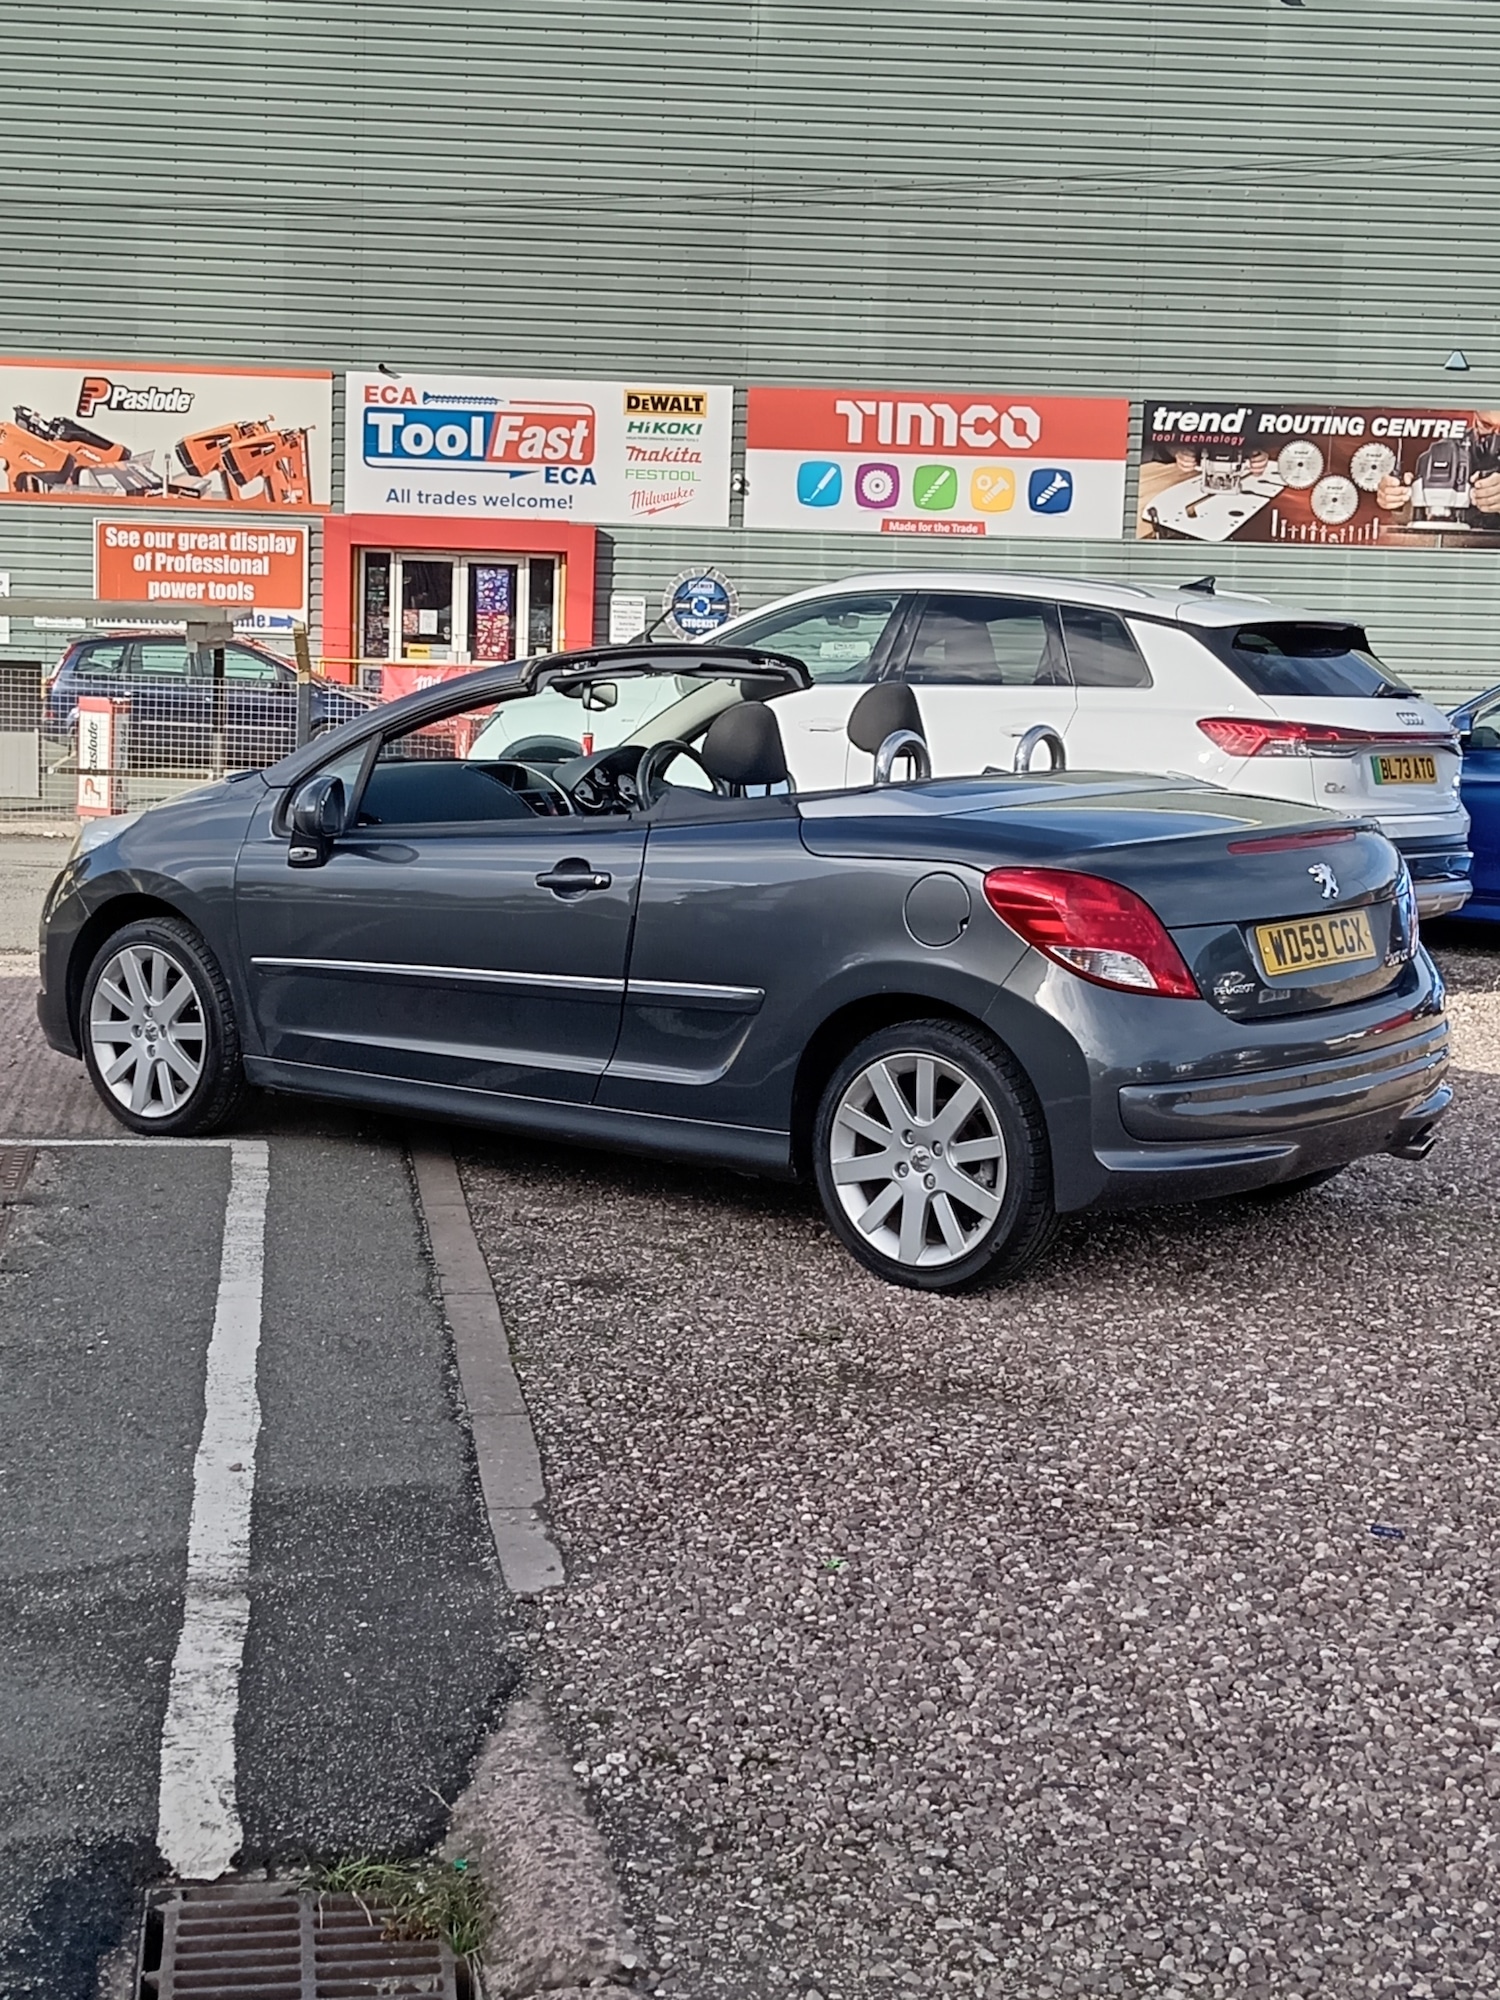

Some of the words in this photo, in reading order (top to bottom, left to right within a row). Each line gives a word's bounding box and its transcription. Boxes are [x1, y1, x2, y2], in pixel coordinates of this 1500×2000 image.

[109, 385, 192, 413] Paslode
[364, 386, 417, 405] ECA
[835, 399, 1042, 449] TIMCO
[1152, 406, 1246, 433] trend
[1258, 413, 1364, 437] ROUTING
[1371, 417, 1467, 439] CENTRE
[1152, 433, 1175, 441] tool
[1180, 433, 1245, 445] technology
[545, 466, 597, 485] ECA
[625, 468, 702, 481] FESTOOL
[386, 488, 411, 504] All
[416, 490, 477, 506] trades
[483, 492, 573, 510] welcome!
[628, 486, 695, 510] Milwaukee
[888, 521, 915, 532] Made
[917, 521, 931, 532] for
[933, 522, 950, 533] the
[951, 523, 978, 534] Trade
[105, 527, 140, 548] See
[143, 530, 174, 549] our
[178, 531, 227, 551] great
[230, 532, 297, 556] display
[133, 552, 153, 572] of
[155, 553, 269, 575] Professional
[148, 581, 205, 600] power
[208, 580, 255, 601] tools
[1380, 758, 1412, 780] BL73
[1414, 758, 1436, 779] ATO
[1267, 926, 1327, 966] WD59
[1328, 916, 1367, 955] CGX
